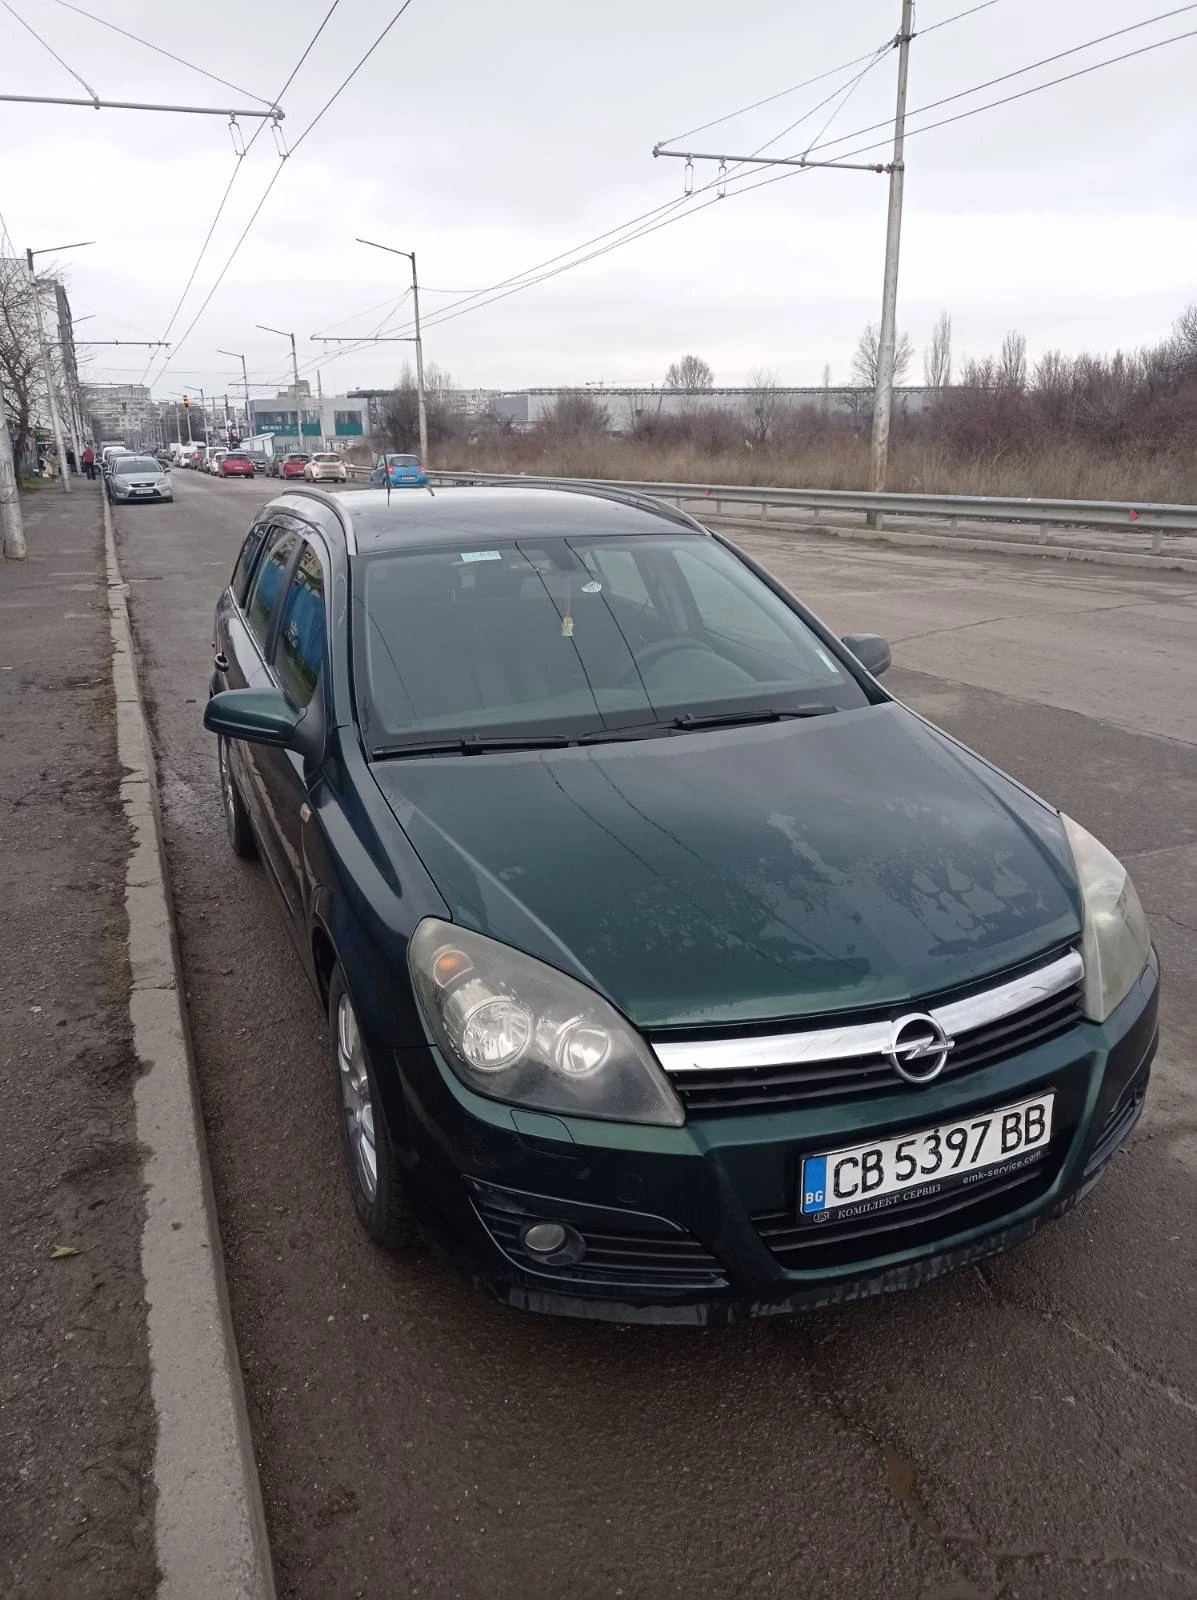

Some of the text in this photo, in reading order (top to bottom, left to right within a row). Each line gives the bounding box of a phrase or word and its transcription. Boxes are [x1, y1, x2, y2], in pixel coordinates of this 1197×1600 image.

[833, 1103, 1046, 1199] CB 5397 BB
[962, 1151, 1041, 1184] emk-service.com
[805, 1190, 824, 1205] BG
[838, 1194, 900, 1219] КОМПЛЕКТ
[903, 1184, 941, 1201] СЕРВИЗ
